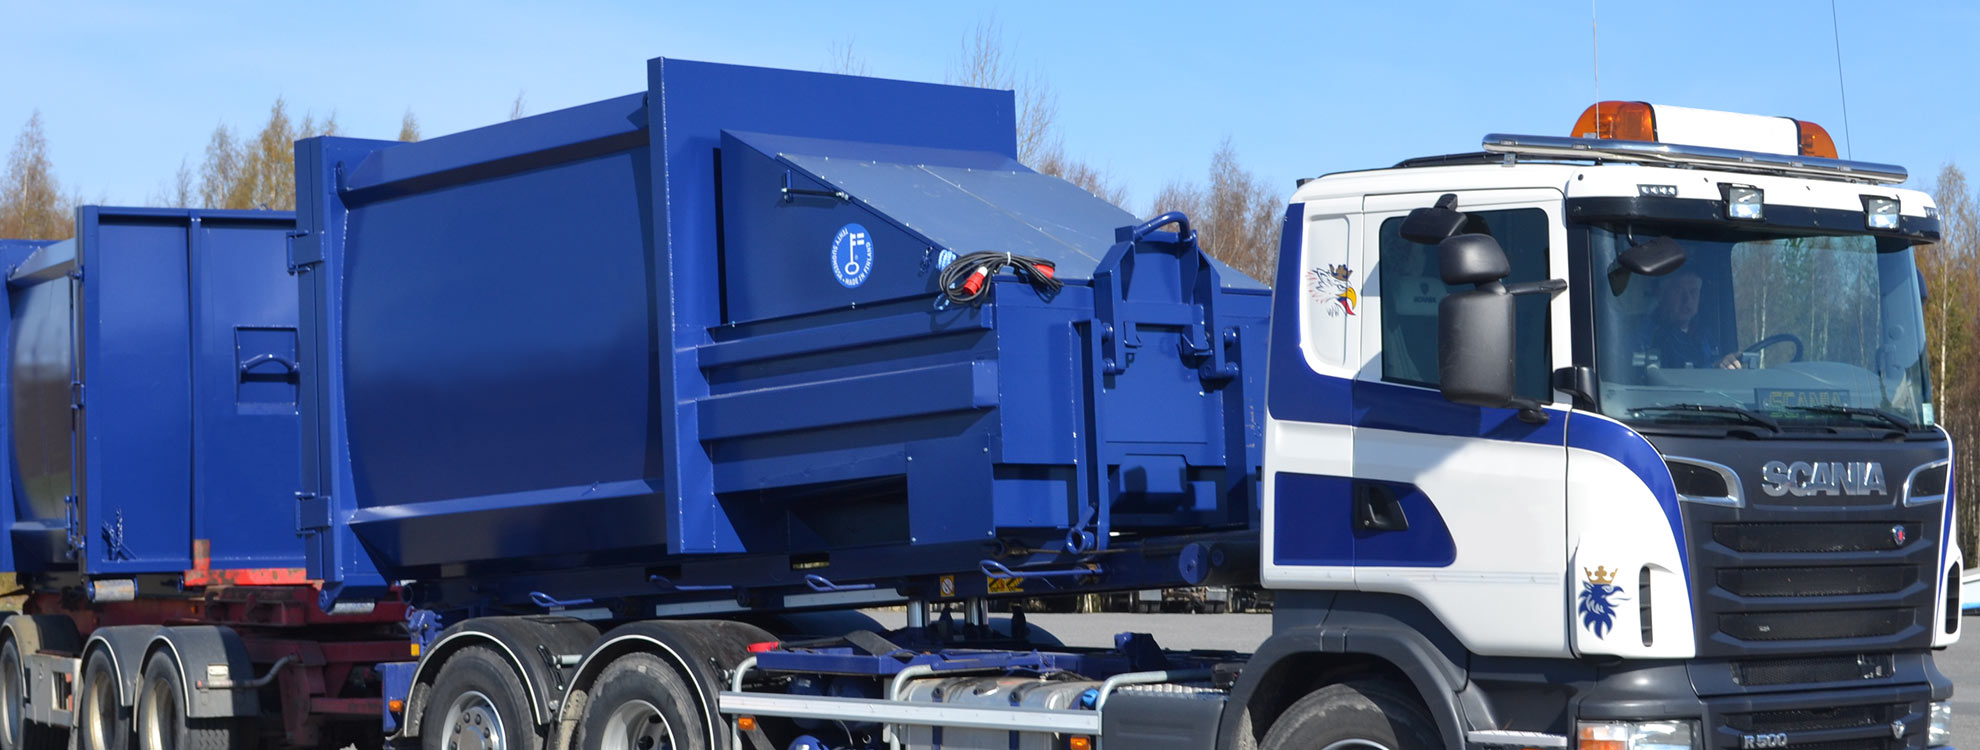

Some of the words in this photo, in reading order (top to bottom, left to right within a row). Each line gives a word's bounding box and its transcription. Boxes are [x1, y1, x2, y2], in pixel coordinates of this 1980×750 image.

[835, 227, 848, 245] TEHTY
[858, 273, 865, 281] IN
[863, 242, 872, 273] FINLAND
[1761, 460, 1888, 497] SCANIA
[1743, 734, 1755, 749] R
[1755, 732, 1788, 748] 500
